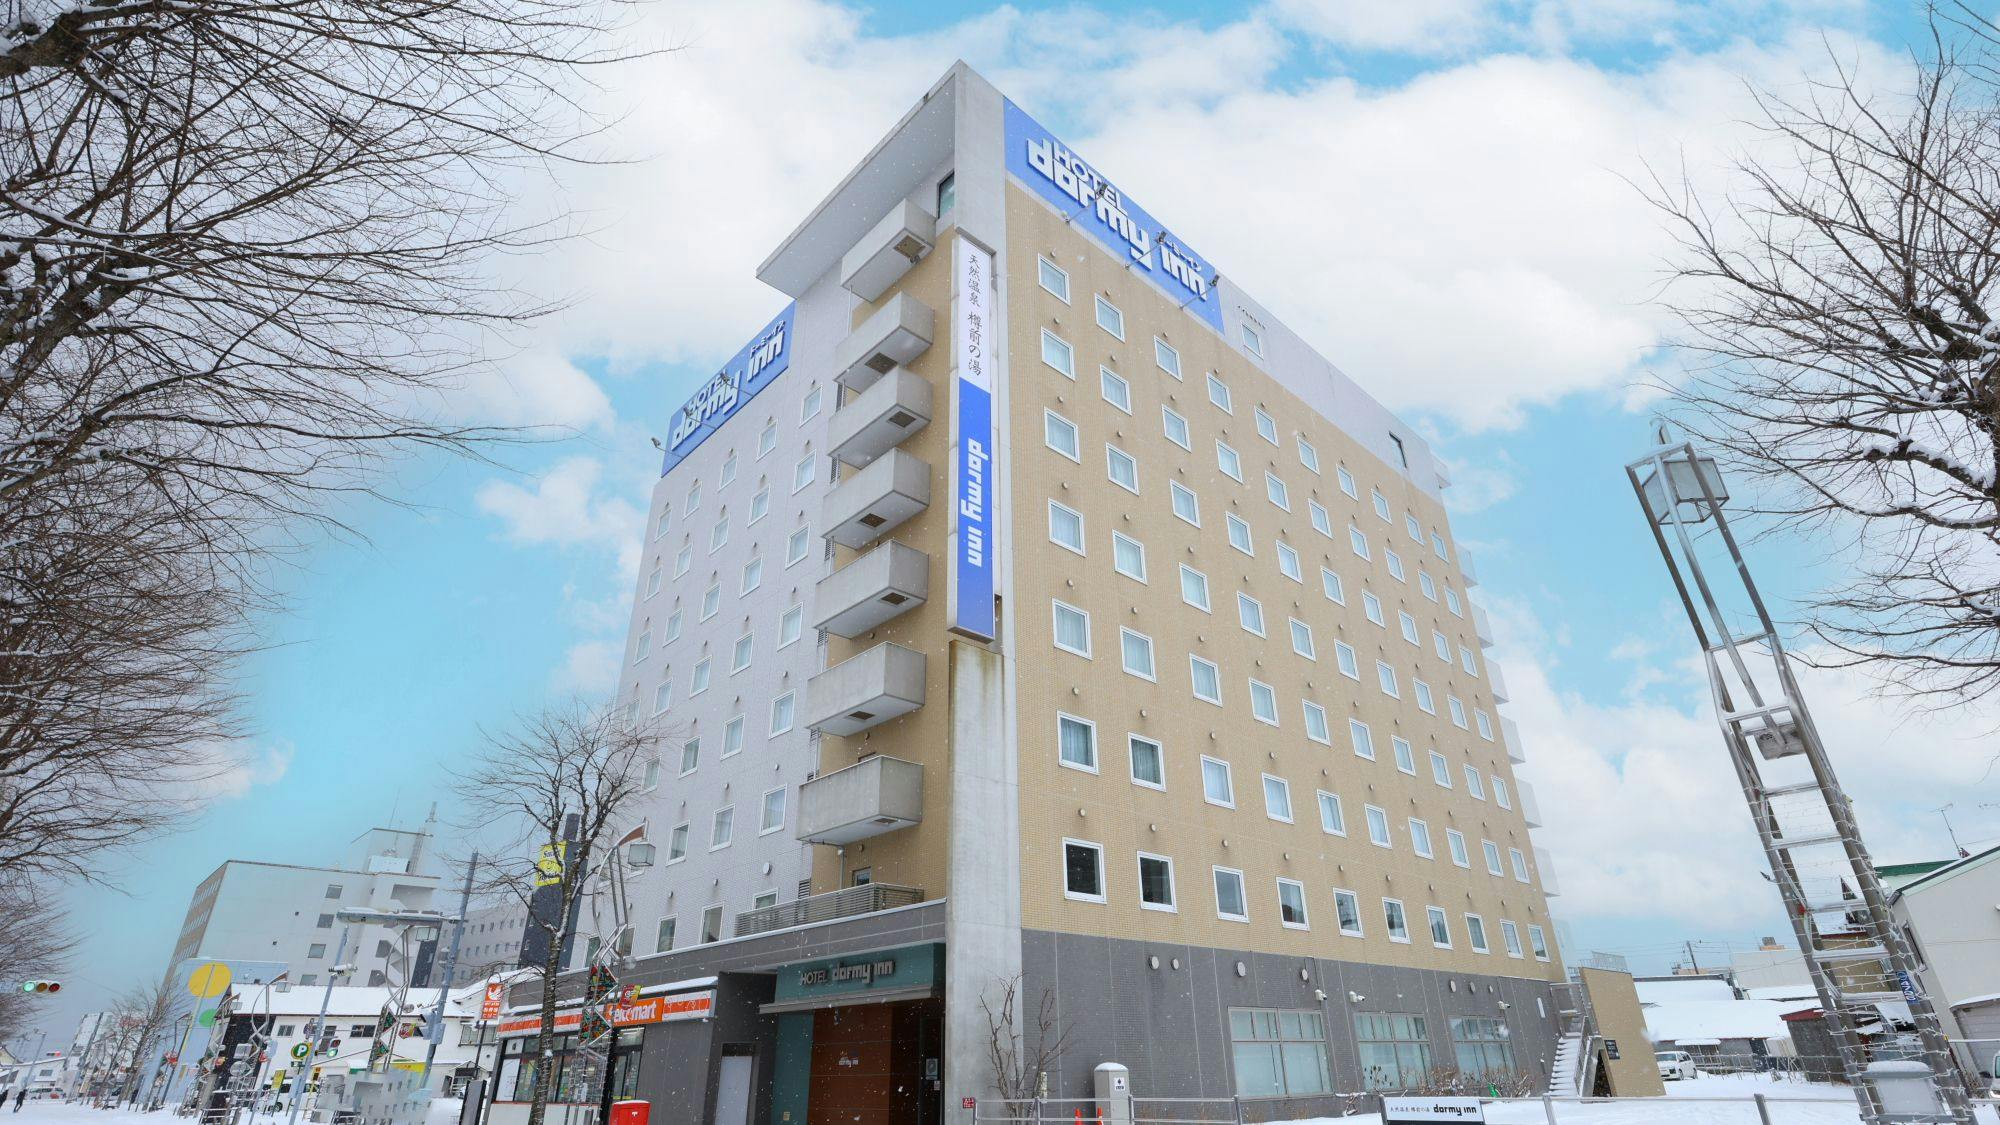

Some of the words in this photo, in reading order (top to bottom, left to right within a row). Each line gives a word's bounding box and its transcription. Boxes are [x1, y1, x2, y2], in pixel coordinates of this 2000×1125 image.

[1053, 141, 1128, 217] HOTEL
[1027, 137, 1153, 271] dormy
[1160, 244, 1207, 301] inn
[968, 254, 981, 307] 天然温泉
[671, 370, 742, 451] dormy
[747, 330, 785, 382] inn
[961, 437, 989, 522] dormy
[967, 525, 982, 568] inn
[800, 970, 828, 985] HOTEL
[832, 962, 871, 984] dormy
[874, 960, 893, 975] inn
[1433, 1104, 1462, 1116] dormy
[1464, 1106, 1477, 1114] inn
